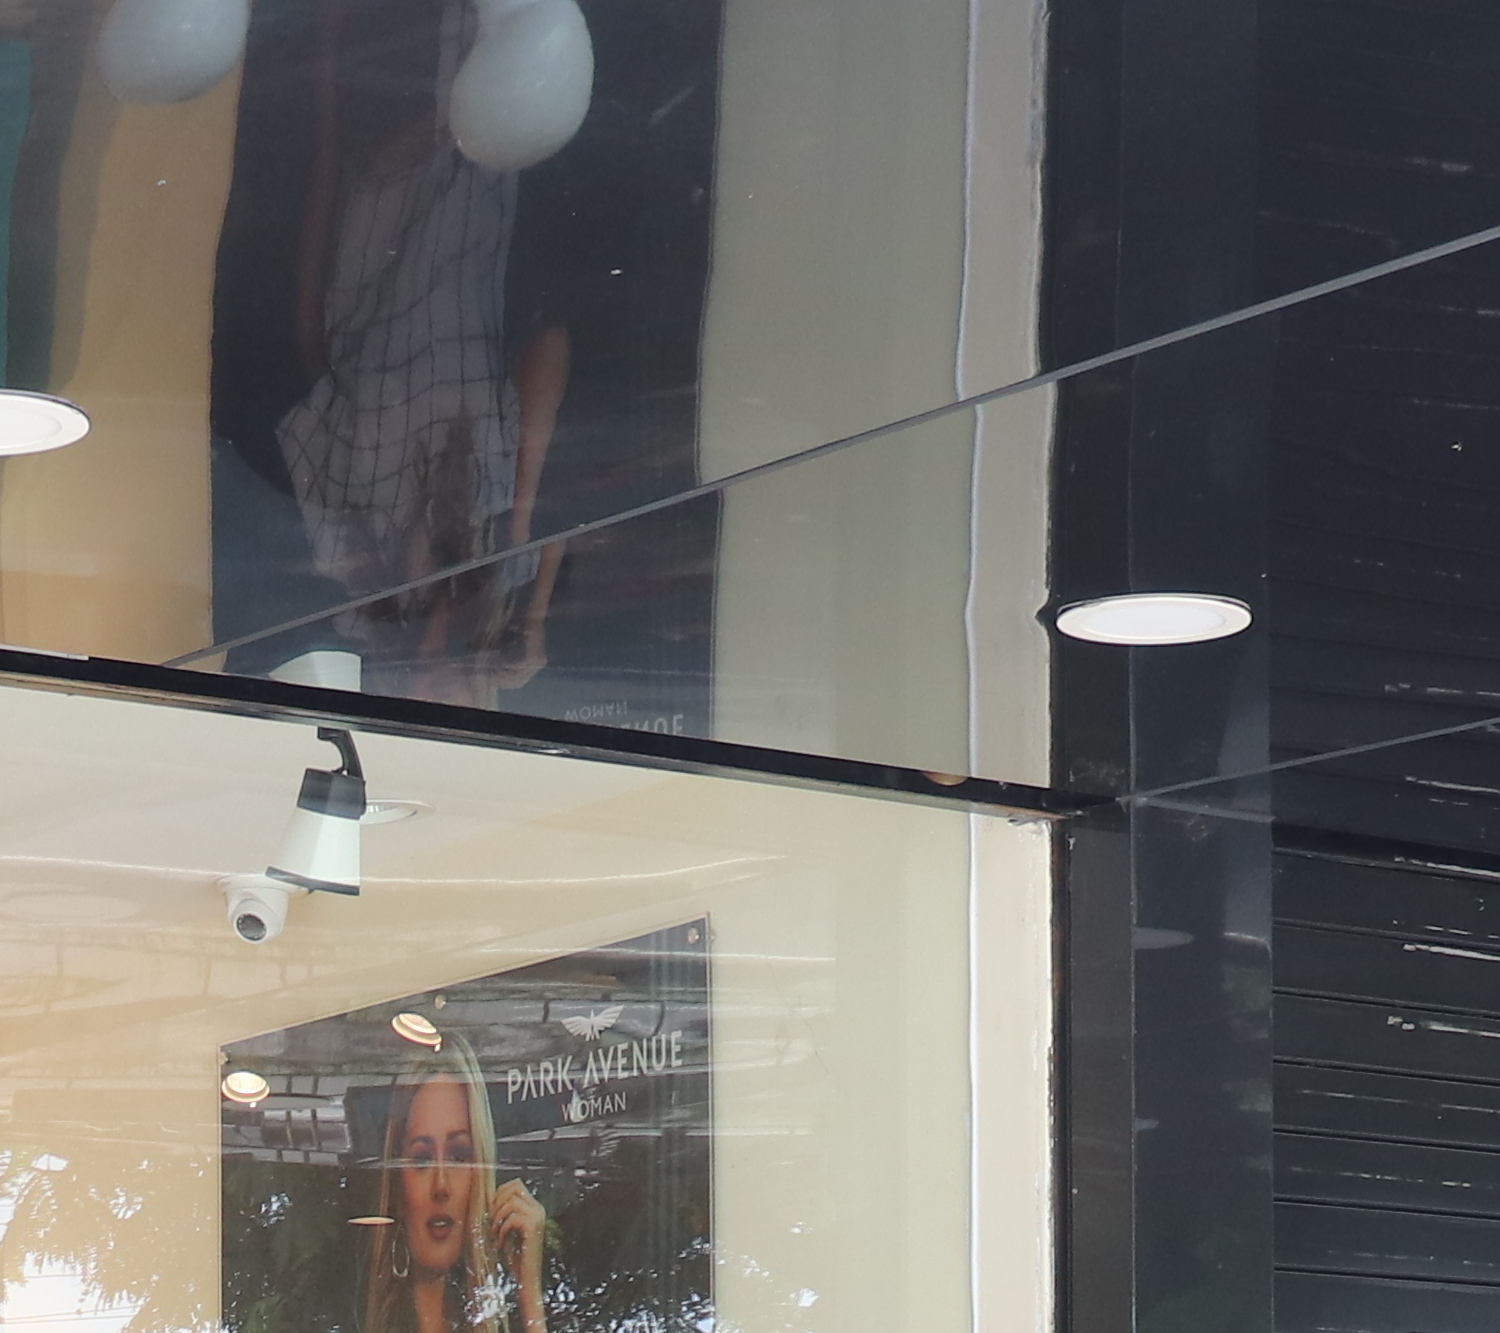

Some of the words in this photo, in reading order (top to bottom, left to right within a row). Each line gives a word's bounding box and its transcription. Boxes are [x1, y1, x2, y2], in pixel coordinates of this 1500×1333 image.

[506, 1053, 573, 1106] PARK
[582, 1029, 684, 1088] AVENUE
[561, 1091, 627, 1122] WOMAN
